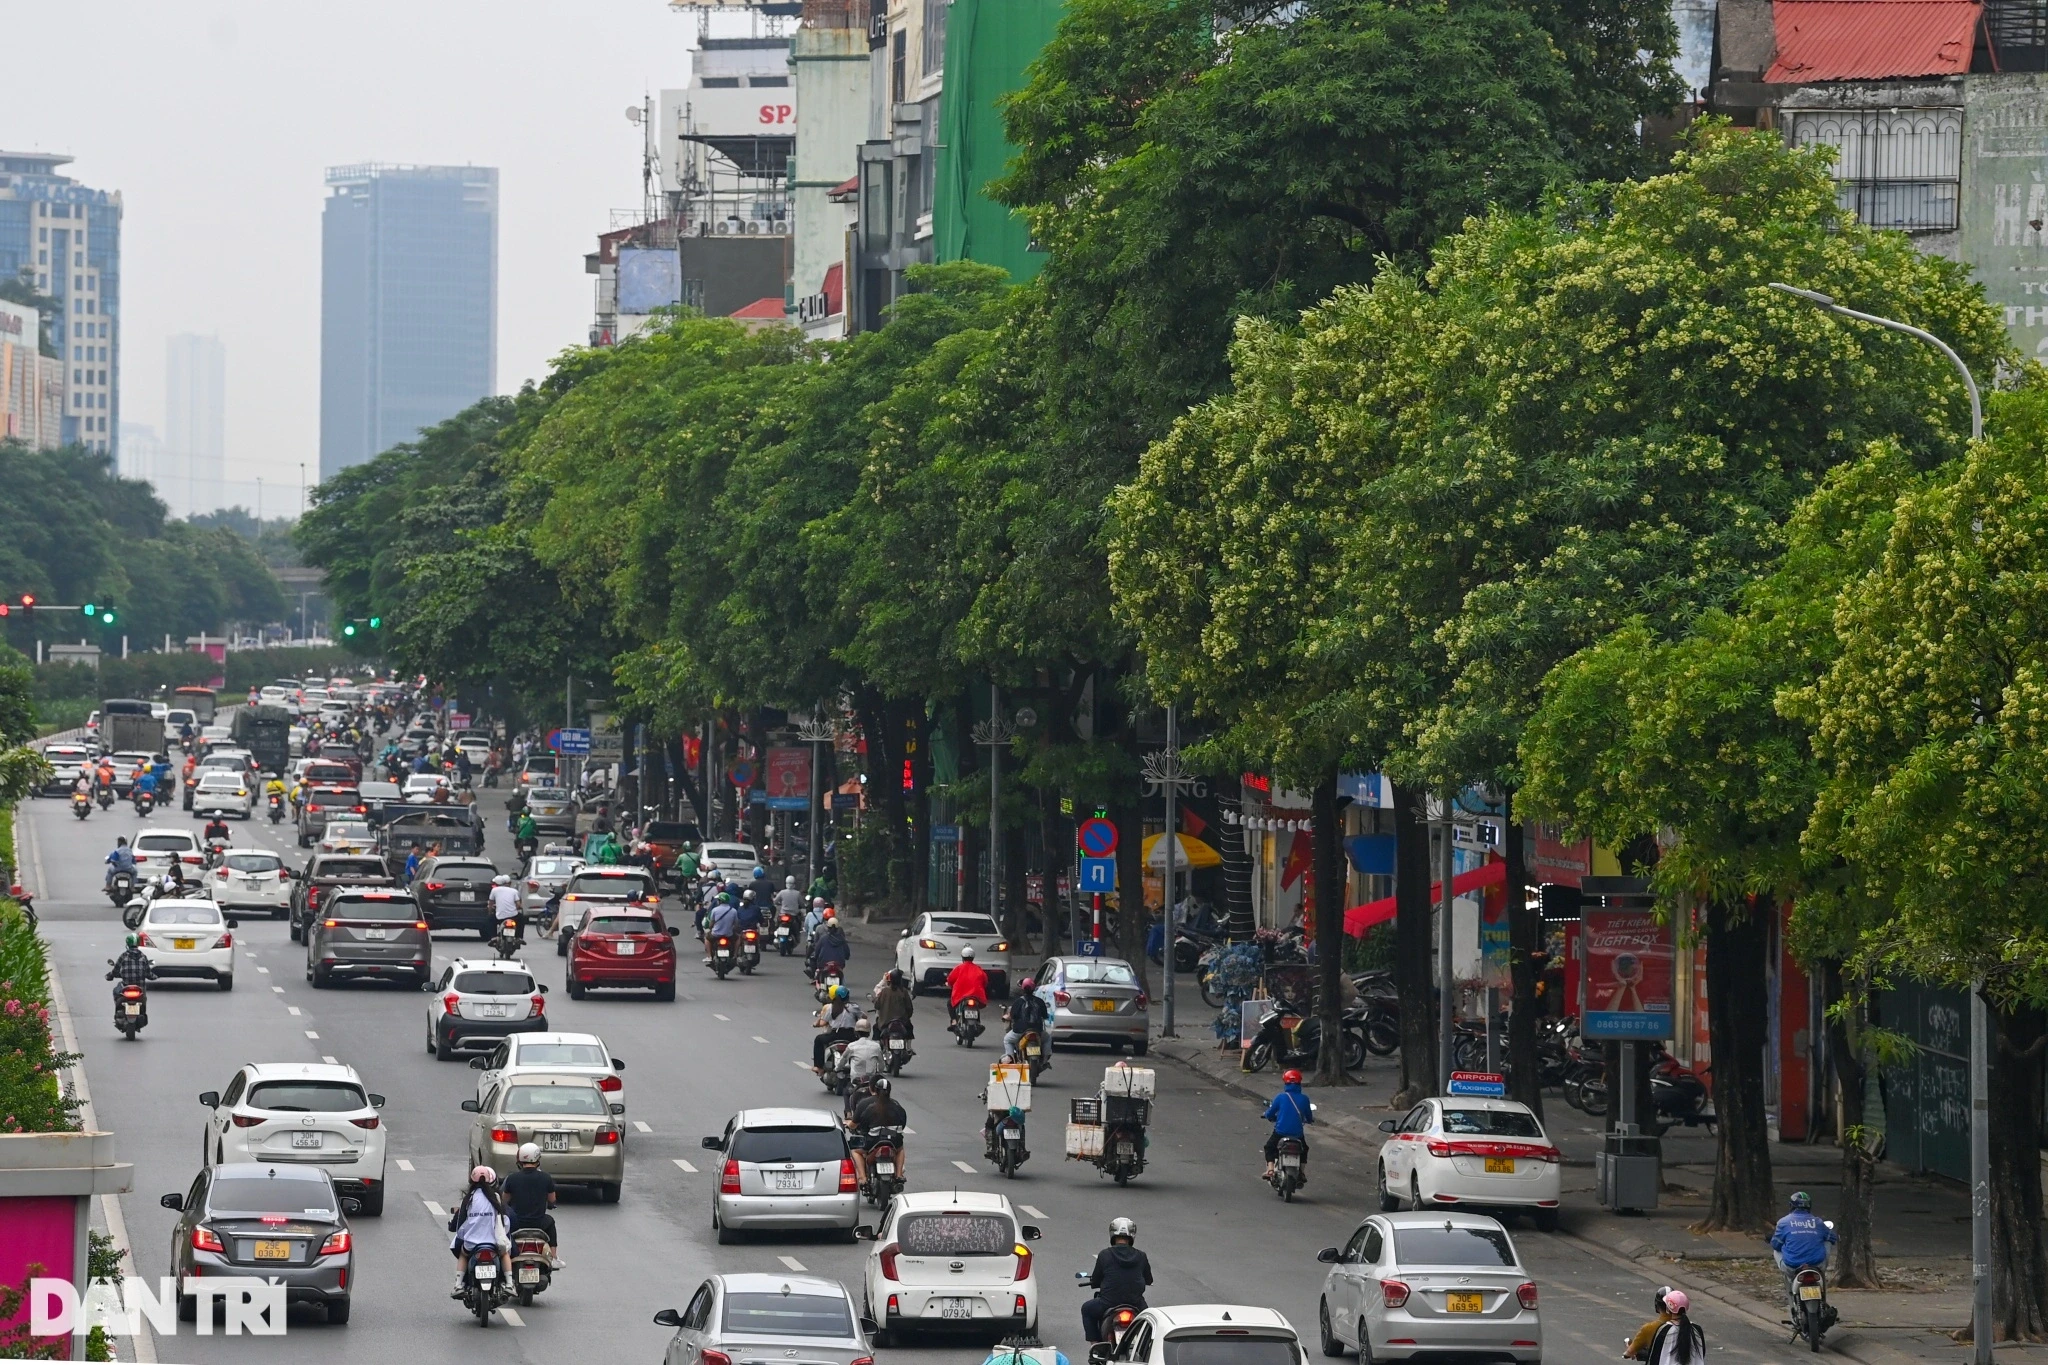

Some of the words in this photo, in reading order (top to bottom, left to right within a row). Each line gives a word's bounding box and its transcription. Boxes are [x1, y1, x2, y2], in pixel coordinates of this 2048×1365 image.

[760, 105, 797, 124] SP
[1593, 936, 1631, 947] LIGHT
[1631, 934, 1660, 945] BOX
[1597, 1020, 1619, 1029] 0865
[1621, 1021, 1633, 1029] 86
[1634, 1021, 1646, 1029] 87
[1647, 1022, 1659, 1030] 86
[1456, 1074, 1499, 1082] AIRPORT
[549, 1133, 563, 1142] 90A
[544, 1142, 567, 1151] 014.81
[783, 1171, 797, 1180] 30A
[777, 1180, 801, 1189] 793.41
[265, 1242, 280, 1250] 29E
[258, 1250, 286, 1258] 038.73
[1457, 1295, 1472, 1303] 30E
[949, 1299, 965, 1309] 29D
[1452, 1303, 1479, 1311] 169.95
[943, 1308, 971, 1319] 079.24
